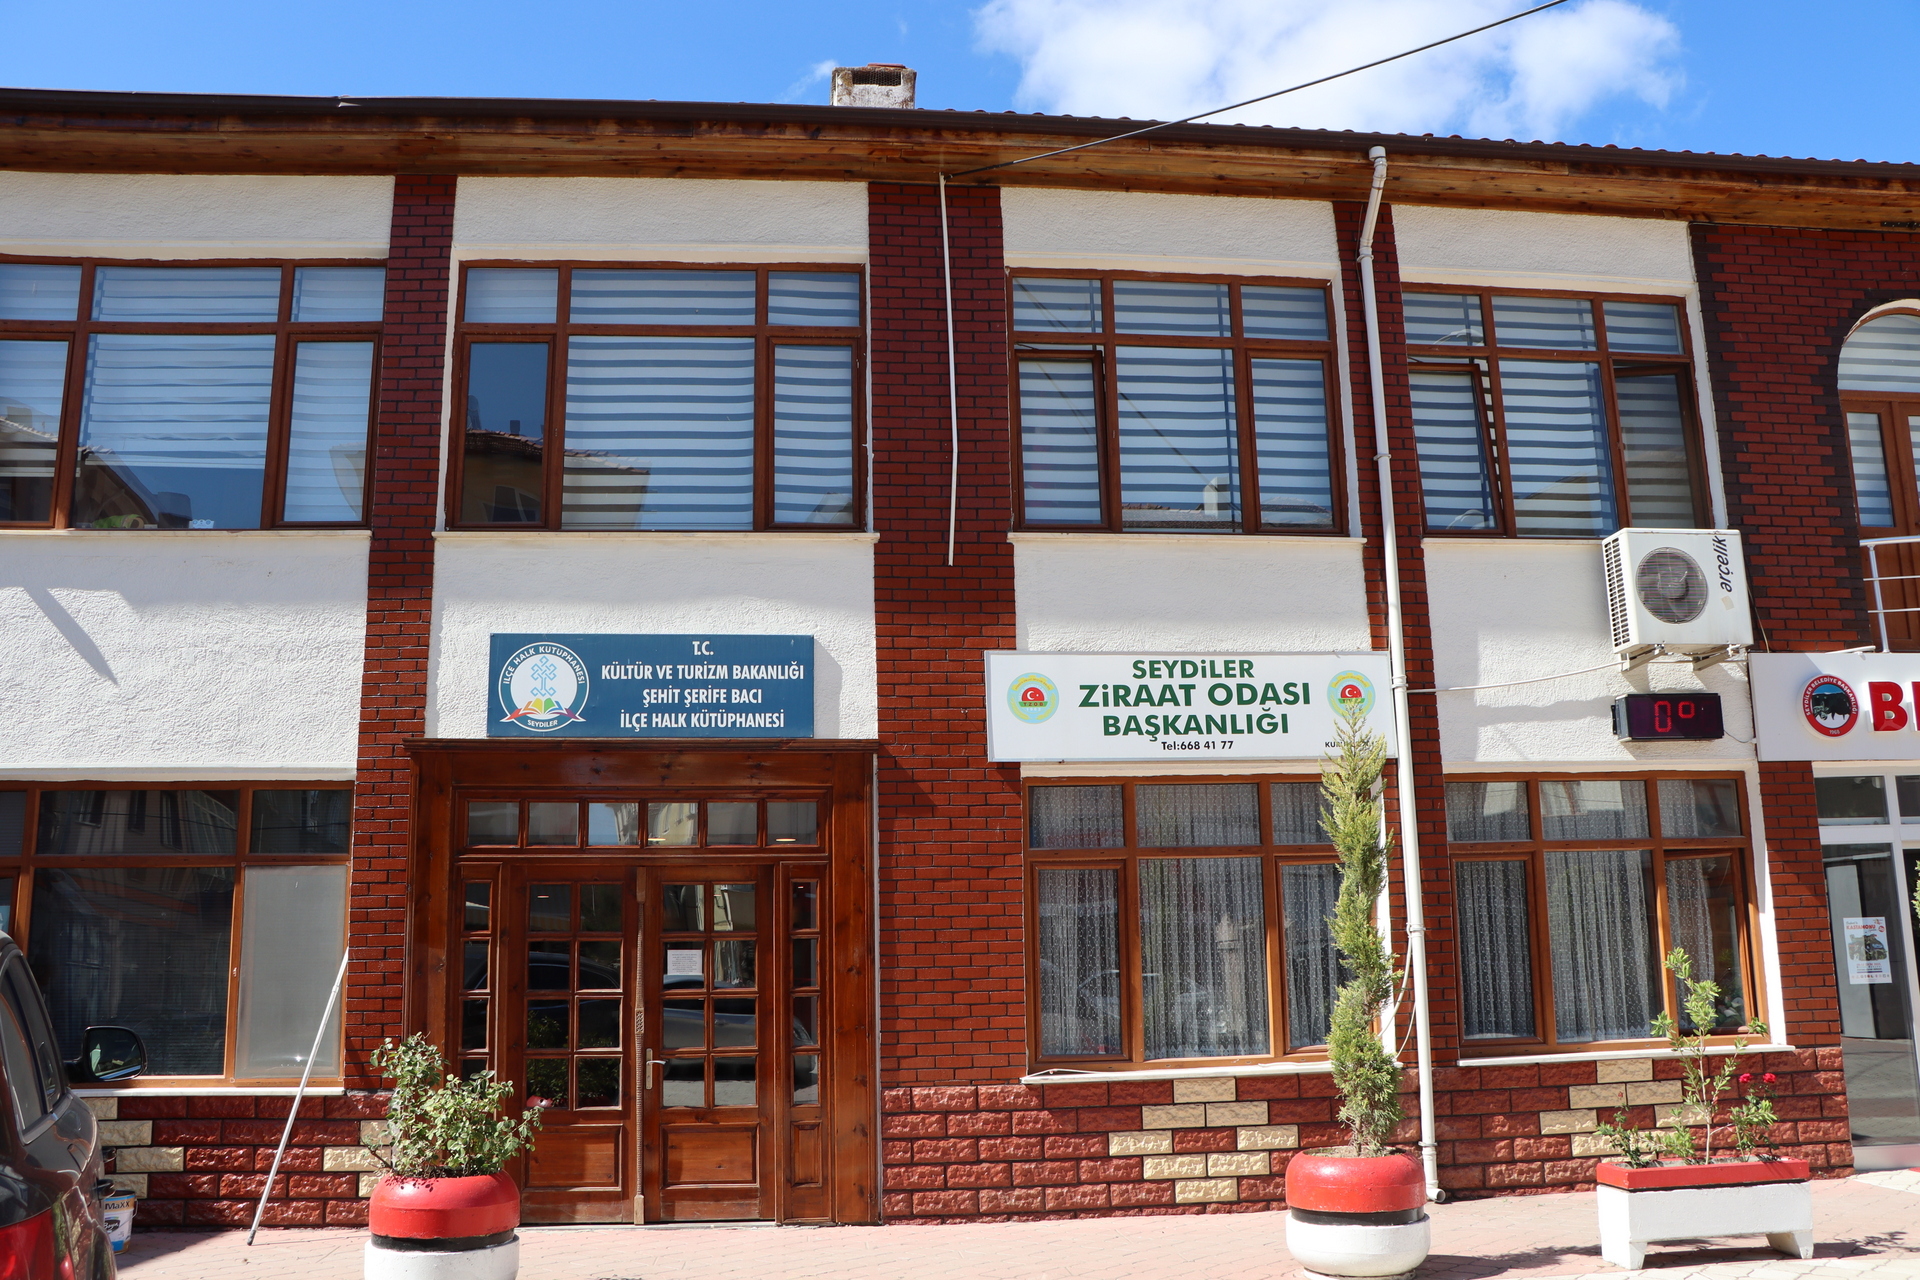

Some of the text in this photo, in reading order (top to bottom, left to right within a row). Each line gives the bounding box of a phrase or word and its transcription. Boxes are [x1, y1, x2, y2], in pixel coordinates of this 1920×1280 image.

[1712, 535, 1734, 593] arçelik
[513, 647, 536, 665] HALK
[692, 641, 714, 655] T.C.
[601, 661, 804, 679] KÜLTÜR VE TURİZM BAKANLIĞI
[1207, 682, 1310, 706] ODASI
[1811, 676, 1838, 690] BELEDİYE
[642, 685, 762, 708] ŞEHİT ŞERİFE BACI
[1868, 681, 1920, 732] B
[620, 709, 785, 732] İLÇE HALK KÜTÜPHANESİ
[1103, 707, 1289, 742] BAŞKANLIĞI
[1204, 741, 1216, 750] 41
[1220, 741, 1234, 749] 77
